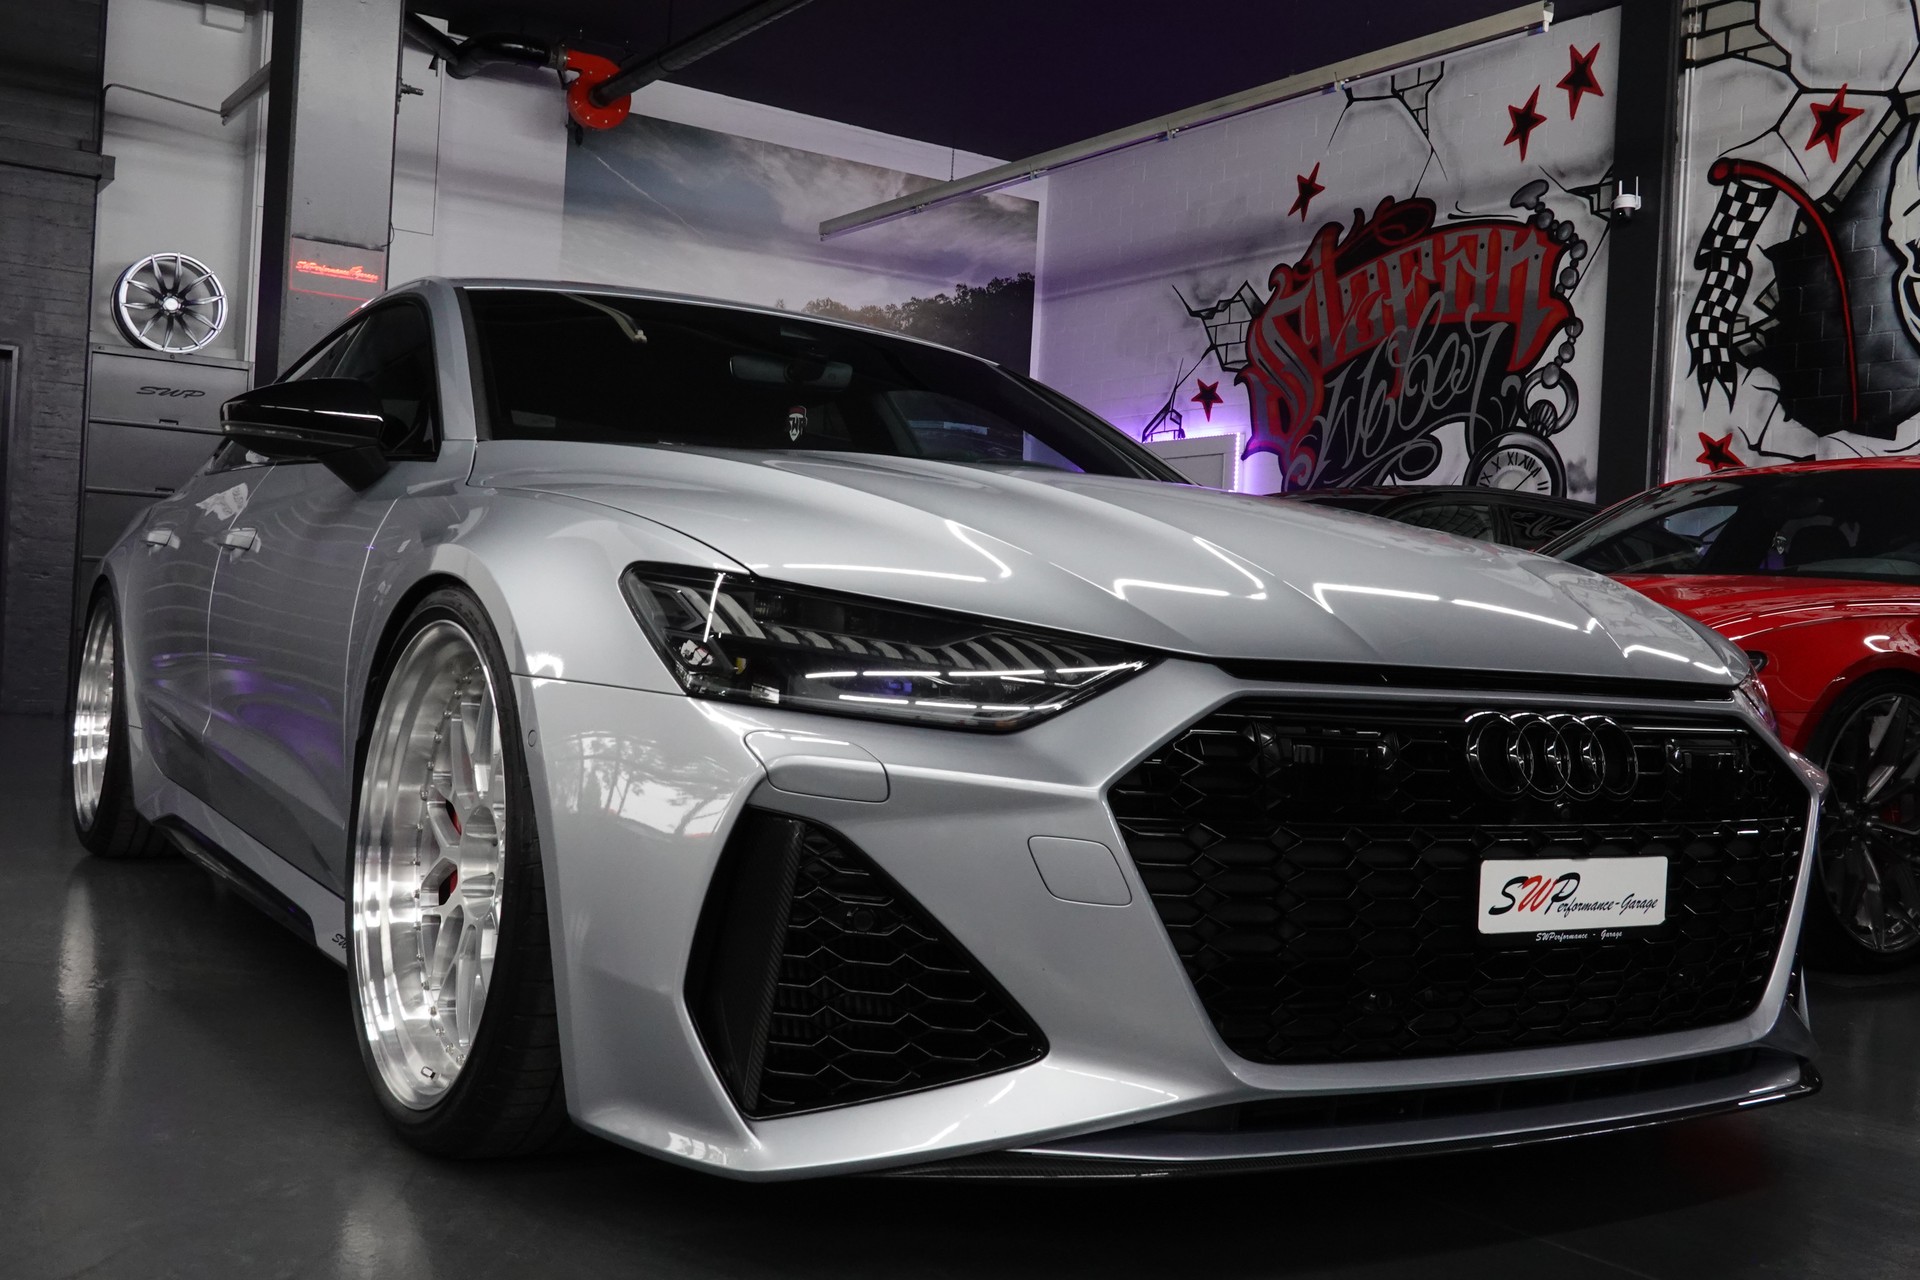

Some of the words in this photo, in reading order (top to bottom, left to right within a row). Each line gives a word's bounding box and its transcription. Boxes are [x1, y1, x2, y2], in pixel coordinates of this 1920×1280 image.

[136, 386, 206, 398] SWP
[1535, 932, 1588, 942] SWPerformance
[1600, 929, 1623, 941] Garage
